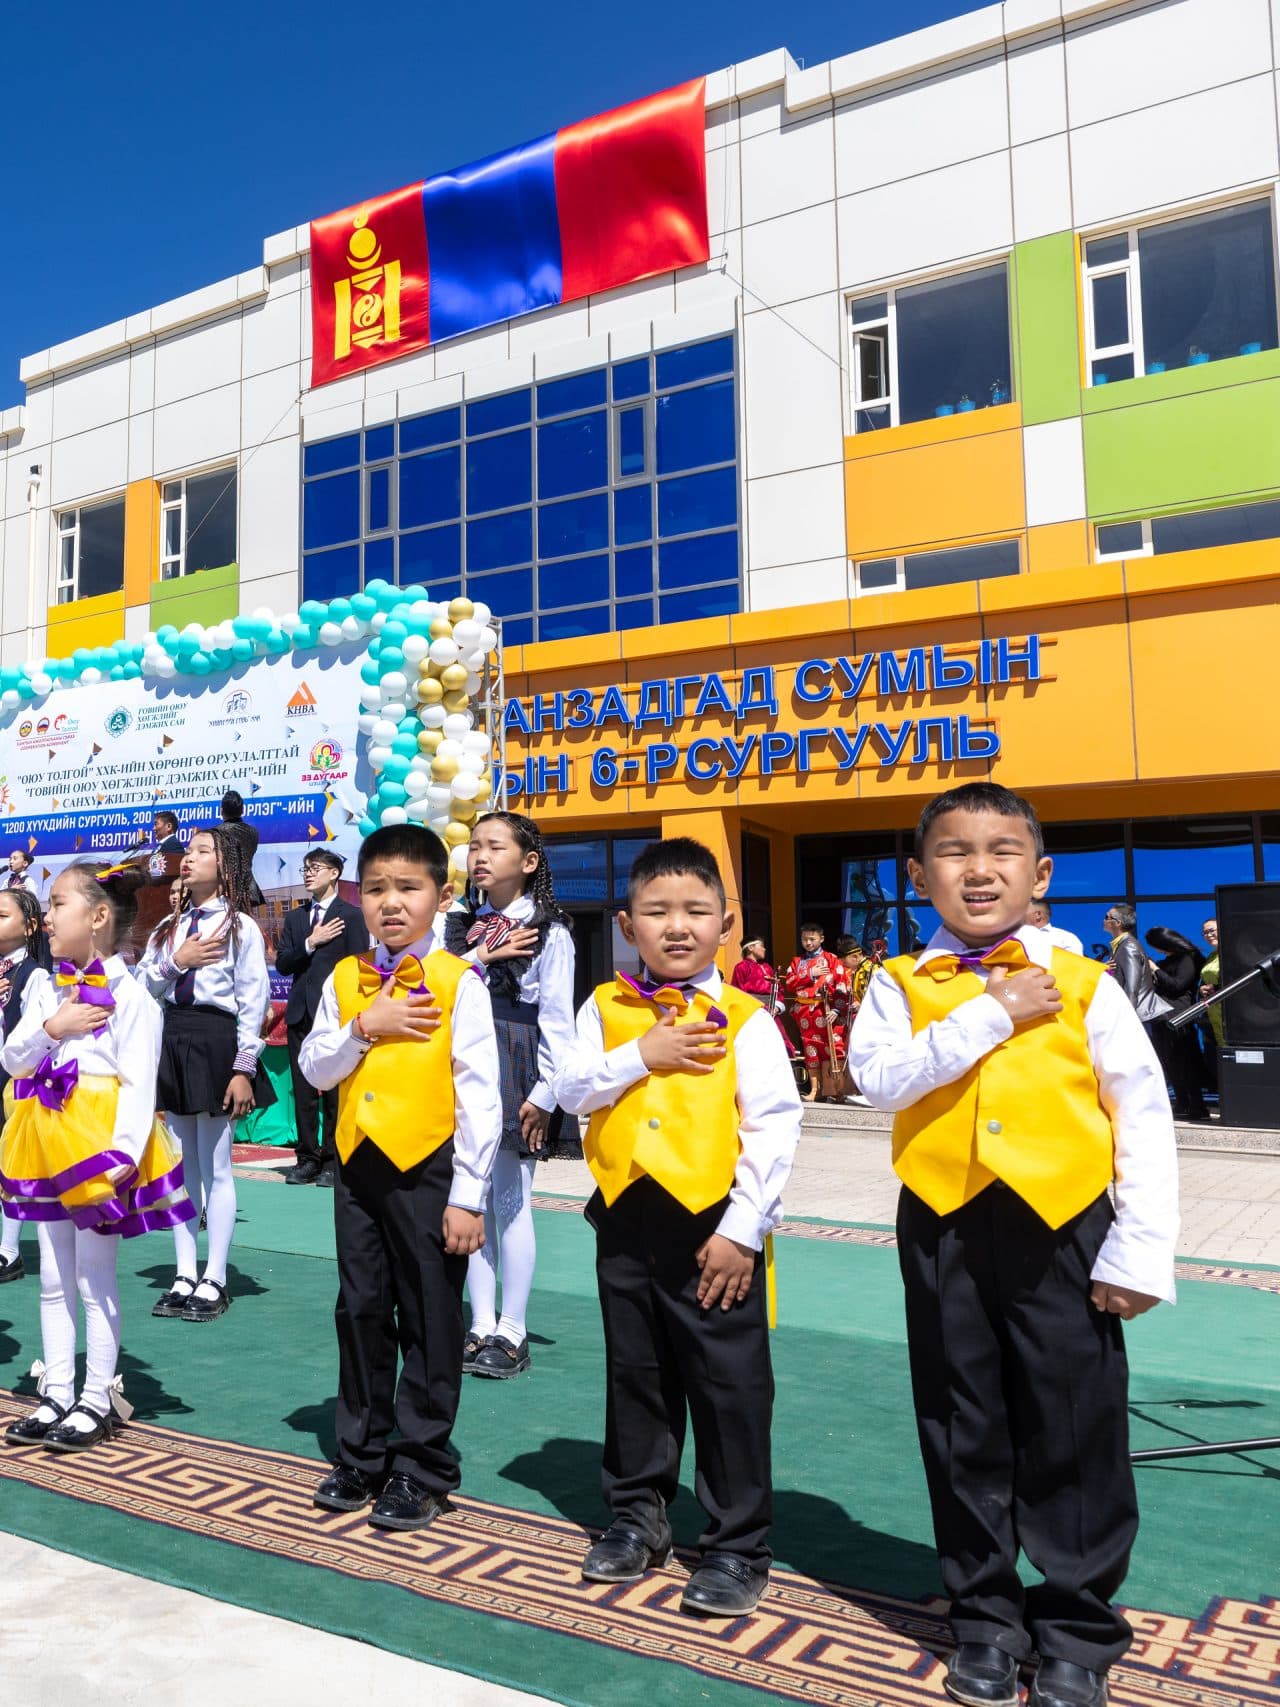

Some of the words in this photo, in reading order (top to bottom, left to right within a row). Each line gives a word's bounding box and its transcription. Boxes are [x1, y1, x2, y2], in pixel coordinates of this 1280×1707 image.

[794, 634, 1040, 703] СУМЫН
[17, 773, 46, 785] "ОЮУ
[47, 767, 94, 782] ТОЛГОЙ"
[96, 760, 146, 777] ХХК-ИЙН
[148, 755, 204, 771] ХӨРӨНГӨ
[207, 745, 300, 765] ОРУУЛАЛТТАЙ
[25, 784, 70, 798] "ГОВИЙН
[73, 780, 98, 793] ОЮУ
[101, 773, 164, 790] ХӨГЖЛИЙГ
[165, 768, 219, 785] ДЭМЖИХ
[222, 763, 287, 780] САН"-ИЙН
[2, 821, 25, 834] "1200
[26, 814, 77, 833] ХҮҮХДИЙН
[78, 810, 131, 829] СУРГУУЛЬ,
[133, 811, 152, 825] 200
